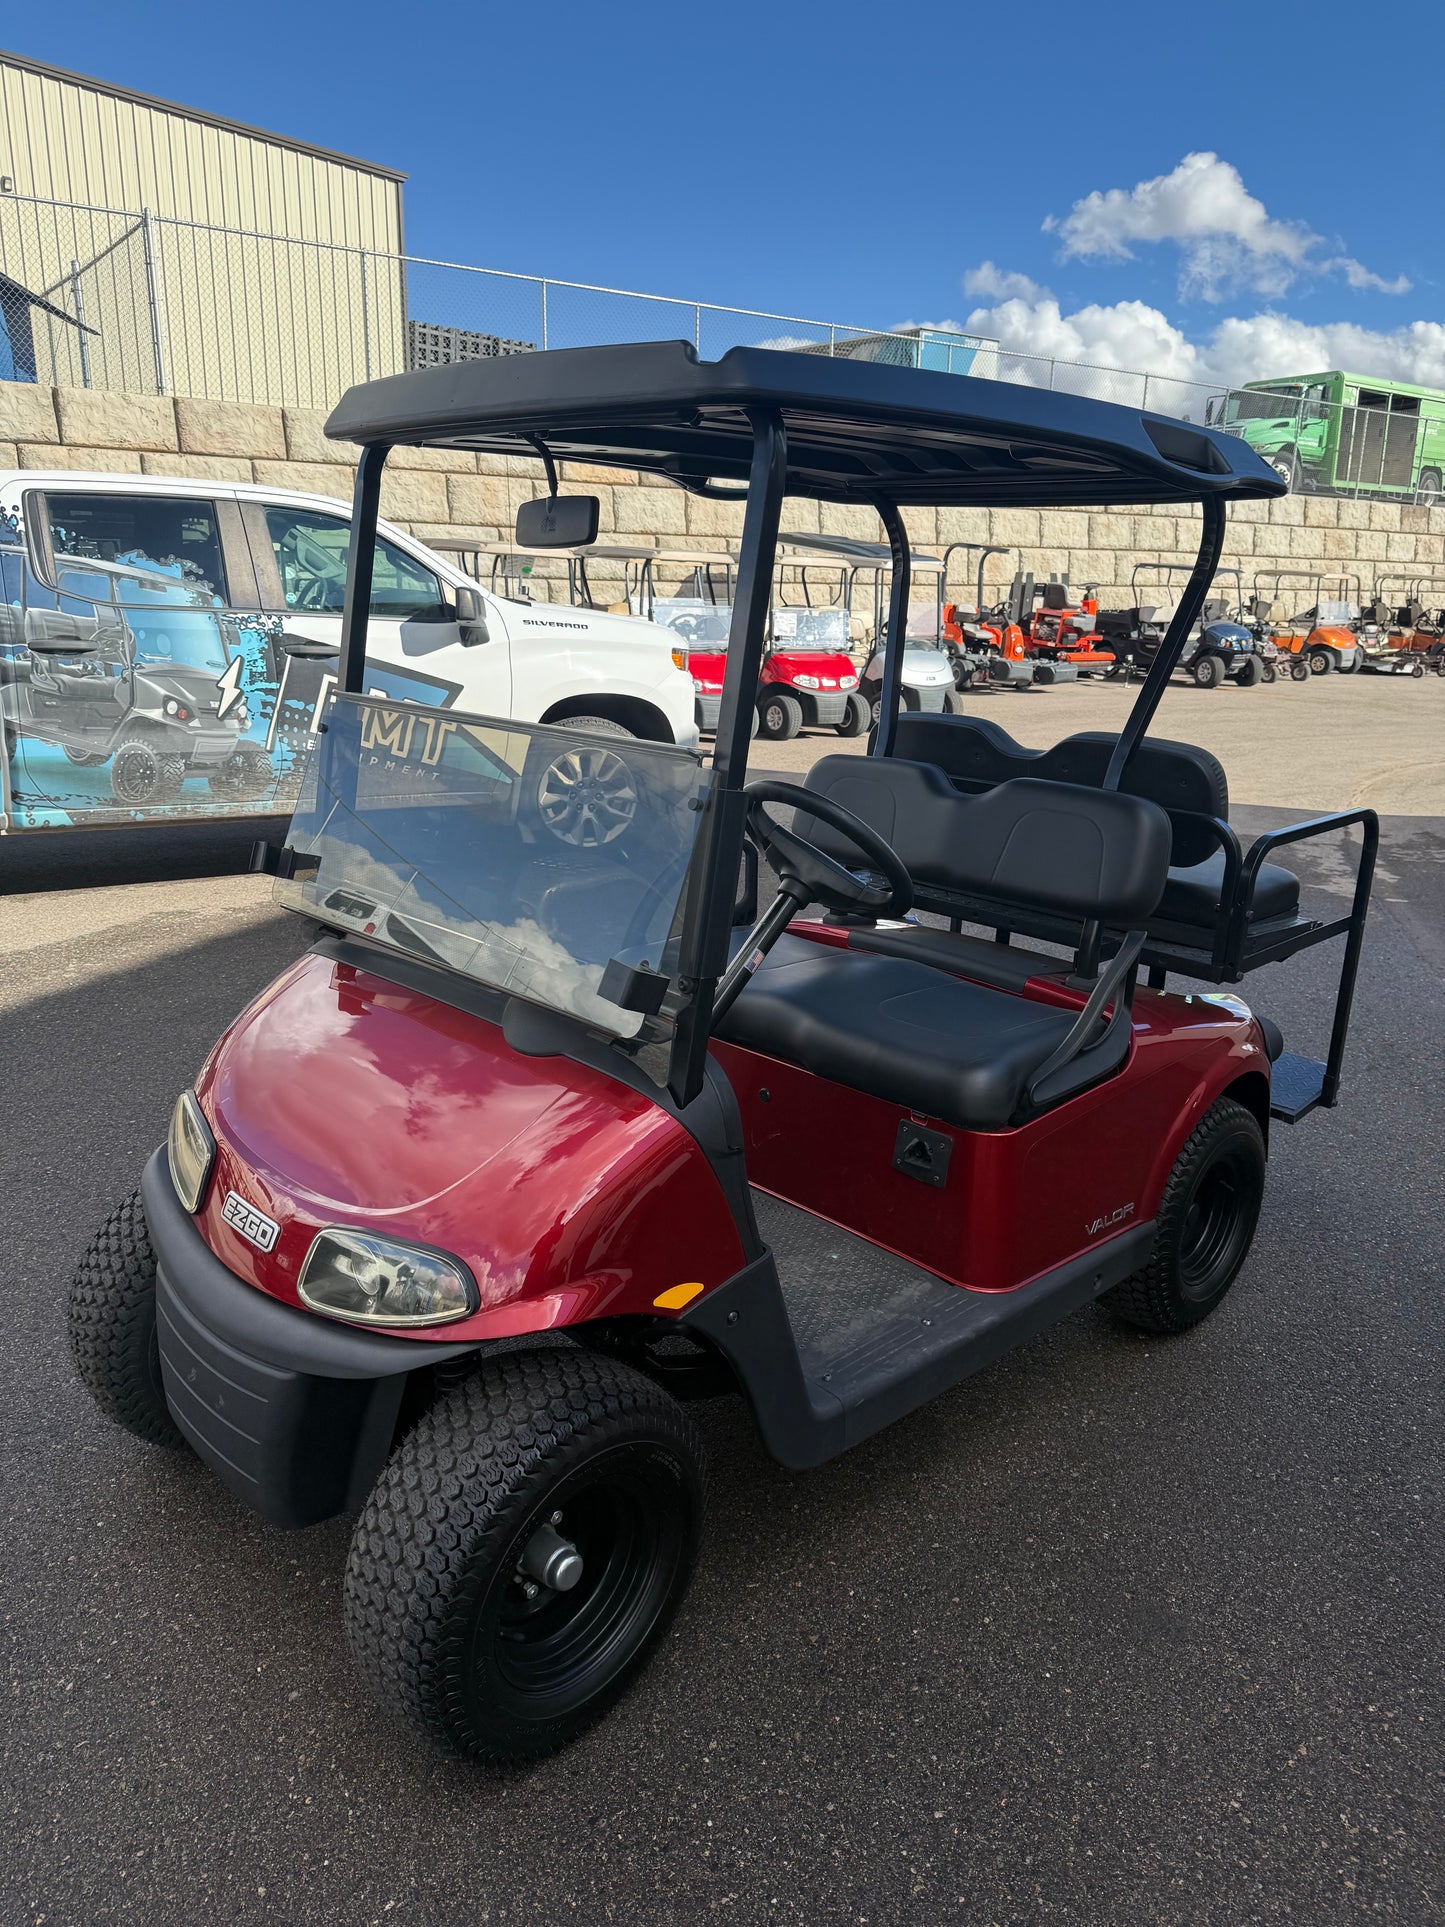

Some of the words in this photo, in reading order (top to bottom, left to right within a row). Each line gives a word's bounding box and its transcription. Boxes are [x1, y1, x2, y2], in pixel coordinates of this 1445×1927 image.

[522, 619, 589, 630] SILVERADO
[223, 1196, 273, 1249] EZGO
[1085, 1202, 1135, 1236] VALOR
